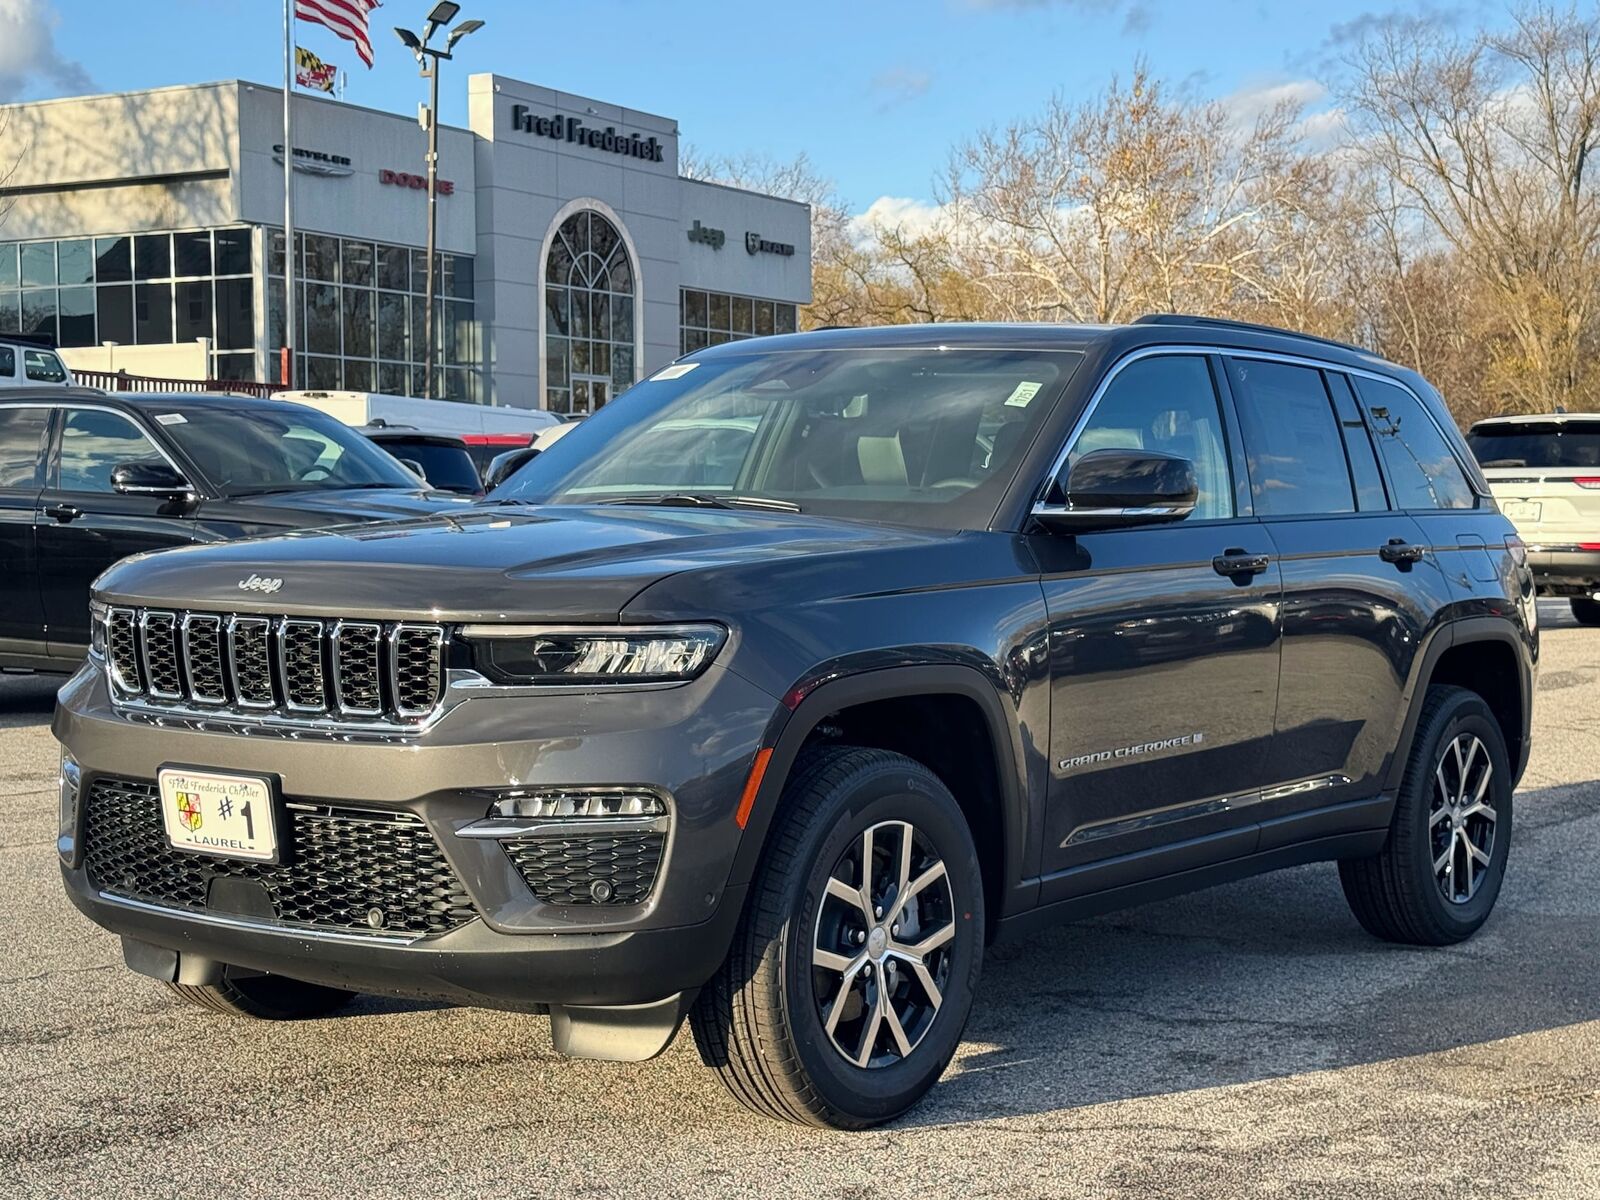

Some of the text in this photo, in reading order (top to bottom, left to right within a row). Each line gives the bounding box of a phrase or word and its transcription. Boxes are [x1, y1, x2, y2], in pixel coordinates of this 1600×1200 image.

[512, 104, 664, 162] Fred Frederick
[687, 219, 725, 251] Jeep
[760, 240, 795, 256] RAM
[238, 573, 284, 593] Jeep
[1059, 735, 1191, 770] GRAND CHEROKEE
[168, 777, 189, 791] Fred
[190, 780, 227, 795] Frederick
